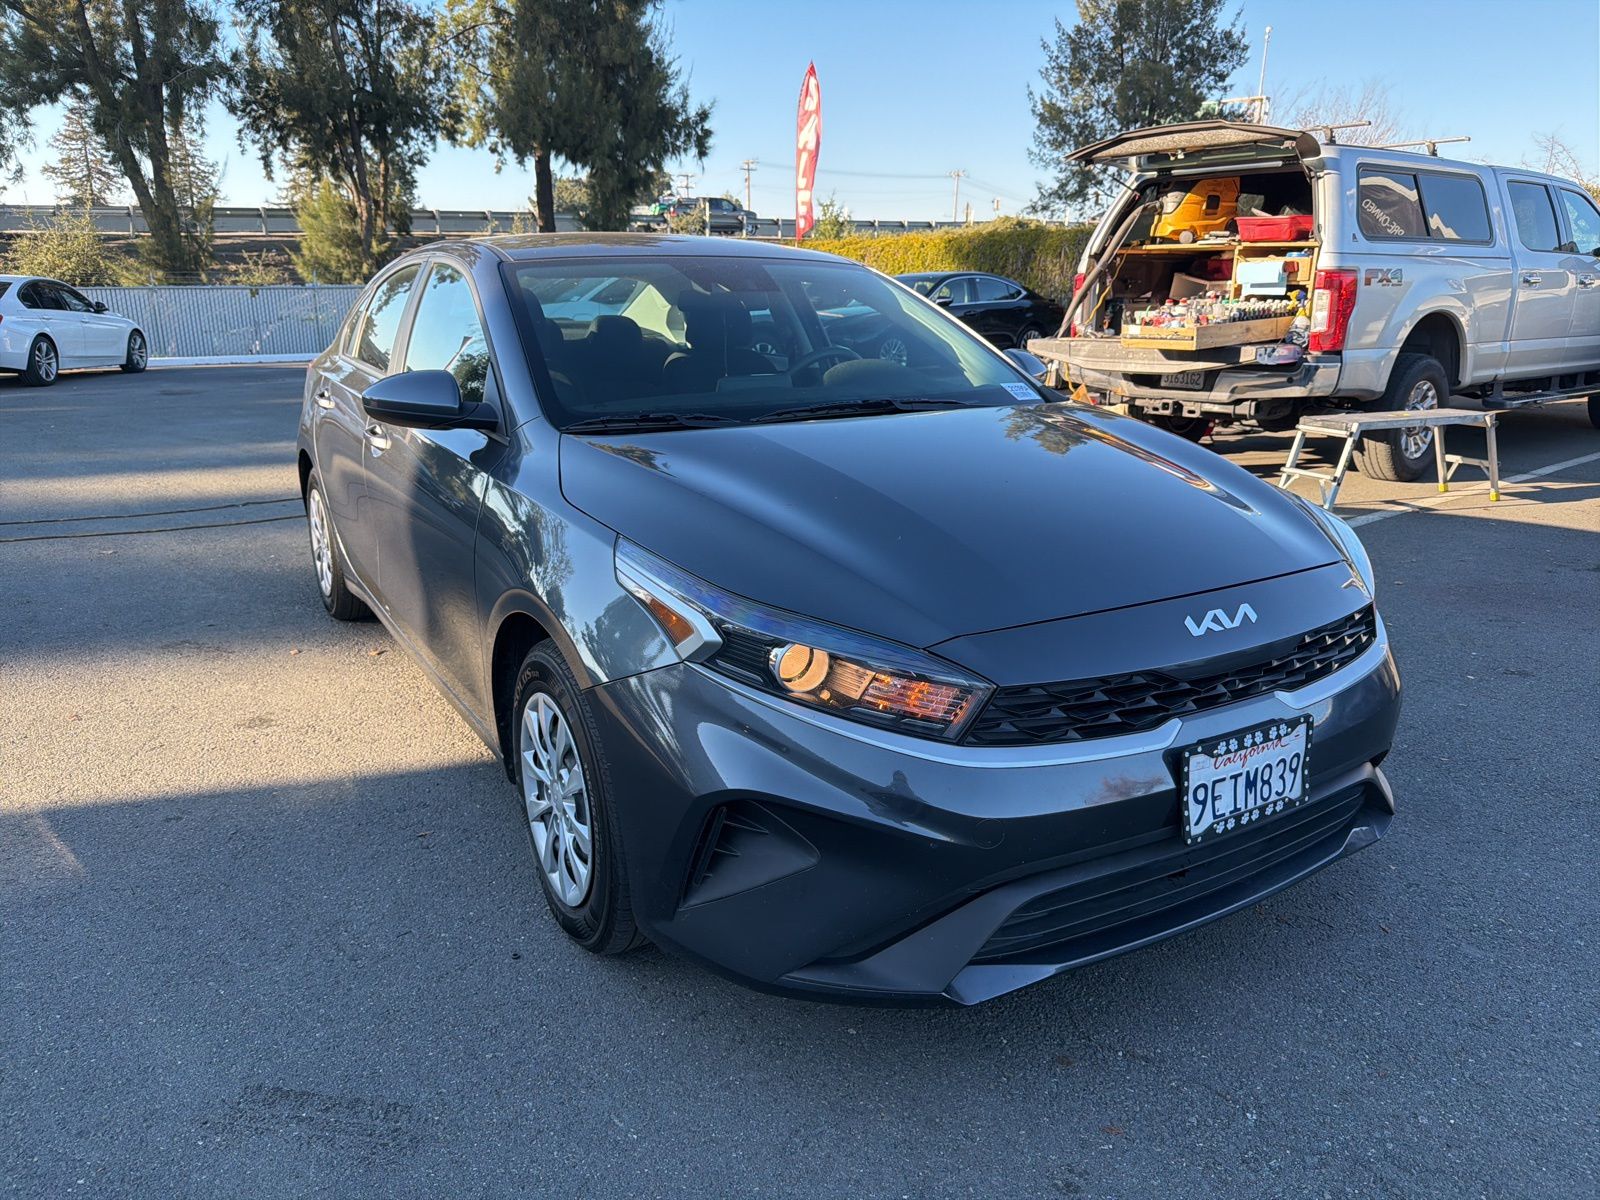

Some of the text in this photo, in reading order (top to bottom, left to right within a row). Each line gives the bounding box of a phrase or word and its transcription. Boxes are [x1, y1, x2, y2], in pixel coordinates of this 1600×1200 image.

[1365, 268, 1403, 286] FX4
[1184, 603, 1258, 637] KIA
[1213, 739, 1290, 771] California
[1192, 752, 1302, 827] 9EIM839
